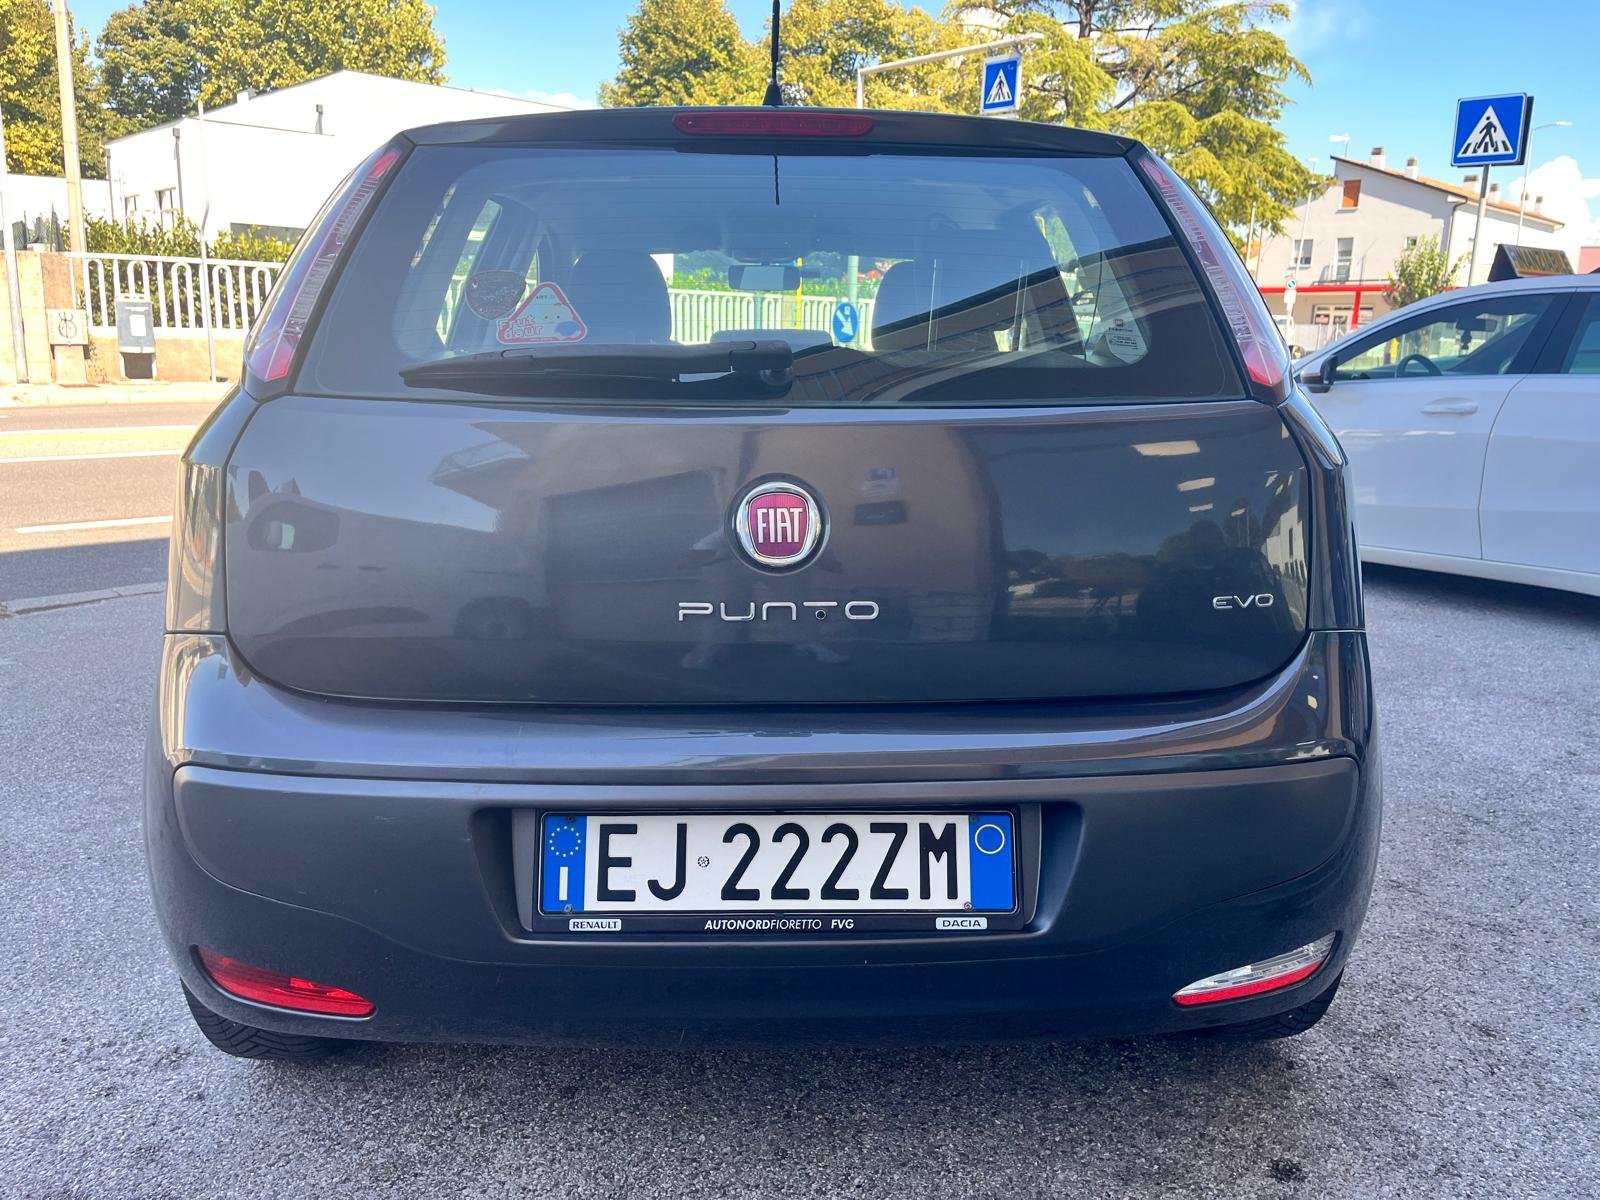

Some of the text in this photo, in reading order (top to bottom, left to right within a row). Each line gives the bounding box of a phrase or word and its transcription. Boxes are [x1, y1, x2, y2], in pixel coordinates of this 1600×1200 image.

[756, 507, 803, 543] FIAT
[678, 600, 880, 622] PUNTO
[1212, 593, 1274, 610] EVO
[597, 822, 959, 902] EJ 222ZM
[558, 866, 569, 901] I
[572, 920, 618, 930] RENAULT
[704, 918, 855, 930] AUTONORDFIORETTO FVG
[941, 919, 982, 928] DACIA
